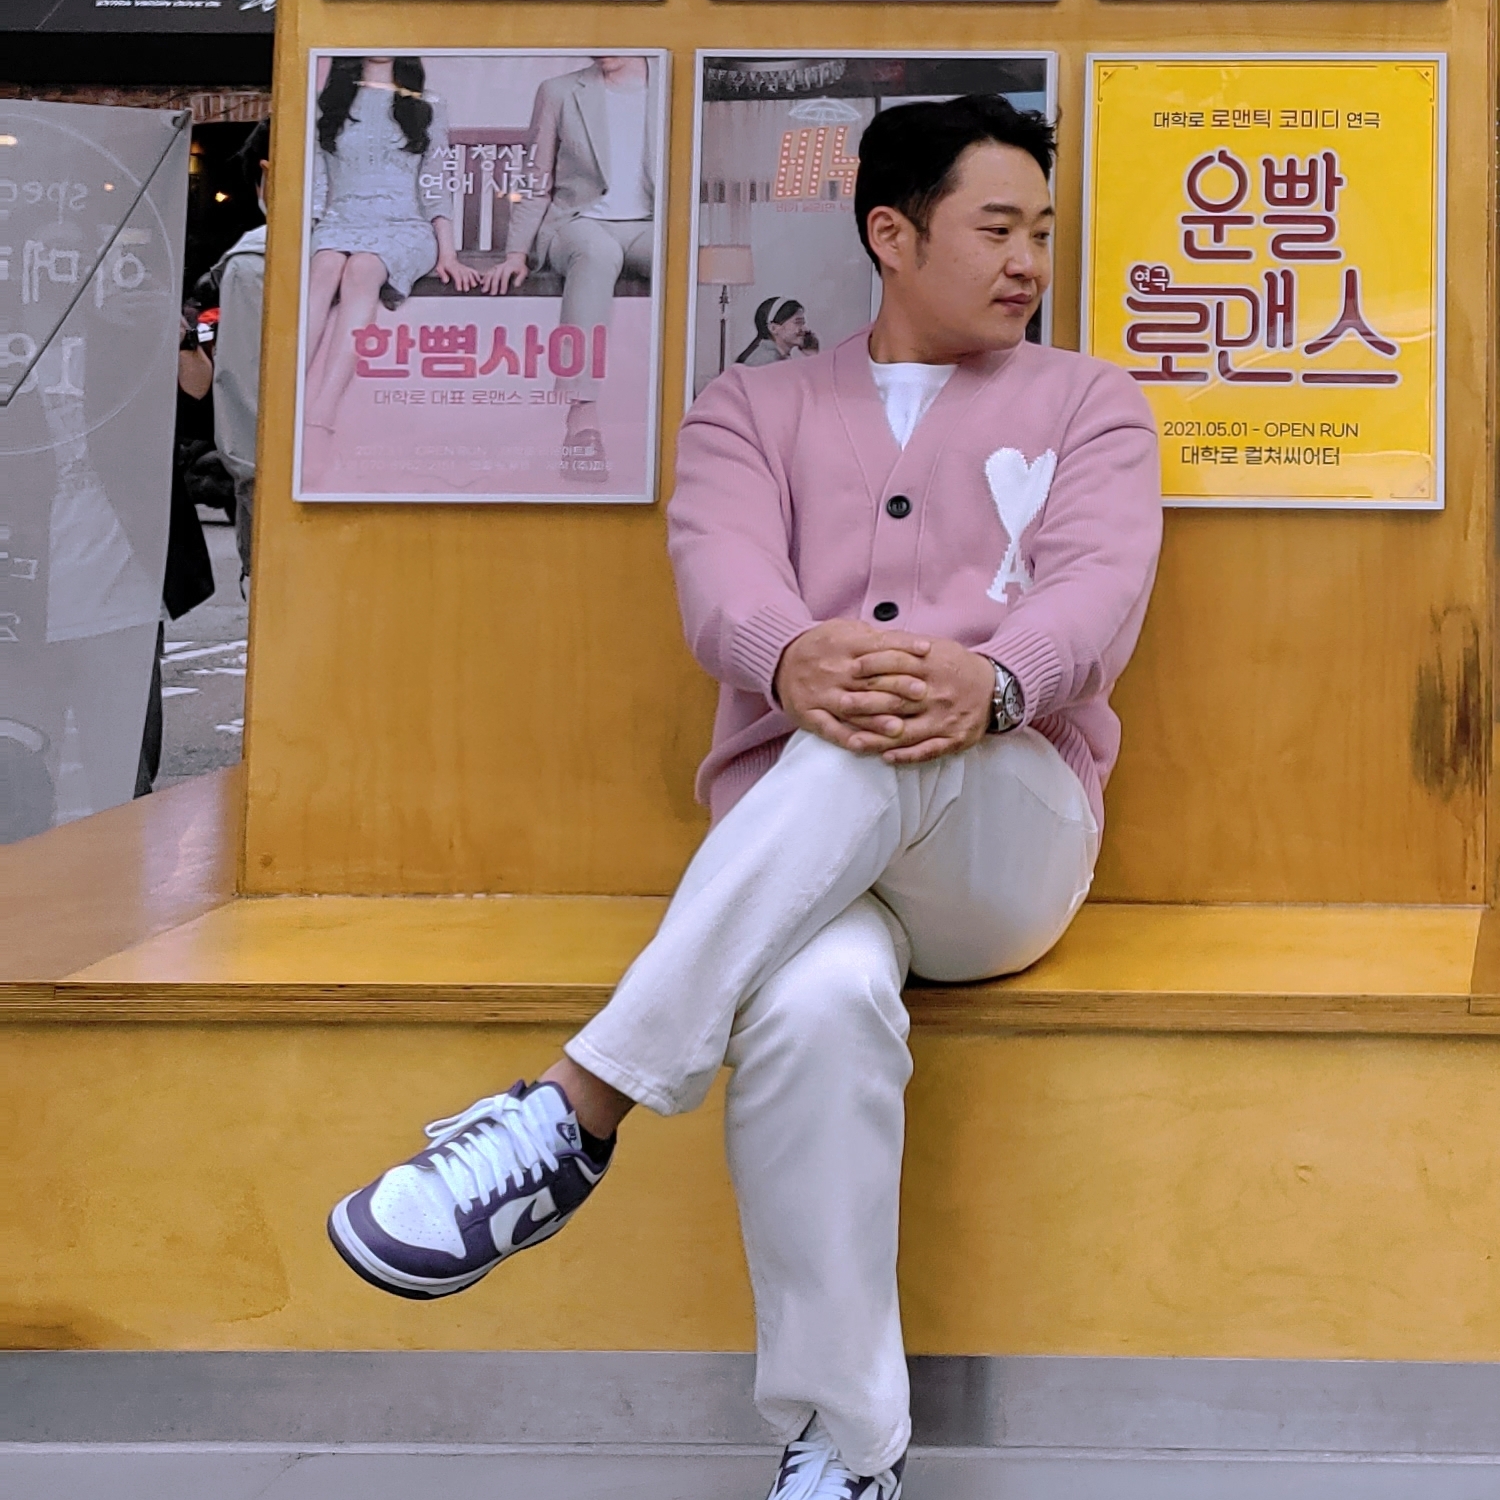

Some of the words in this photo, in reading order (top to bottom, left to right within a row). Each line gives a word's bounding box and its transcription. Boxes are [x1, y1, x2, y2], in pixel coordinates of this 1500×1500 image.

[1154, 111, 1204, 129] 대학로
[1211, 108, 1272, 130] 로맨틱
[1279, 108, 1340, 130] 코미디
[1346, 111, 1381, 130] 연극
[431, 144, 466, 171] 썸
[469, 144, 538, 171] 청산!
[418, 172, 474, 199] 연애
[484, 172, 550, 199] 시작!
[1180, 148, 1345, 262] 운빨
[1133, 266, 1169, 292] 연극
[1126, 268, 1400, 384] 로맨스
[352, 323, 607, 379] 한뼘사이
[374, 389, 426, 406] 대학로
[431, 389, 466, 406] 대표
[471, 389, 523, 406] 로맨스
[1163, 421, 1249, 438] 2021.05.01
[1264, 422, 1316, 439] OPEN
[1320, 422, 1359, 439] RUN
[1181, 445, 1239, 467] 대학로
[1244, 445, 1341, 468] 컬쳐씨어터
